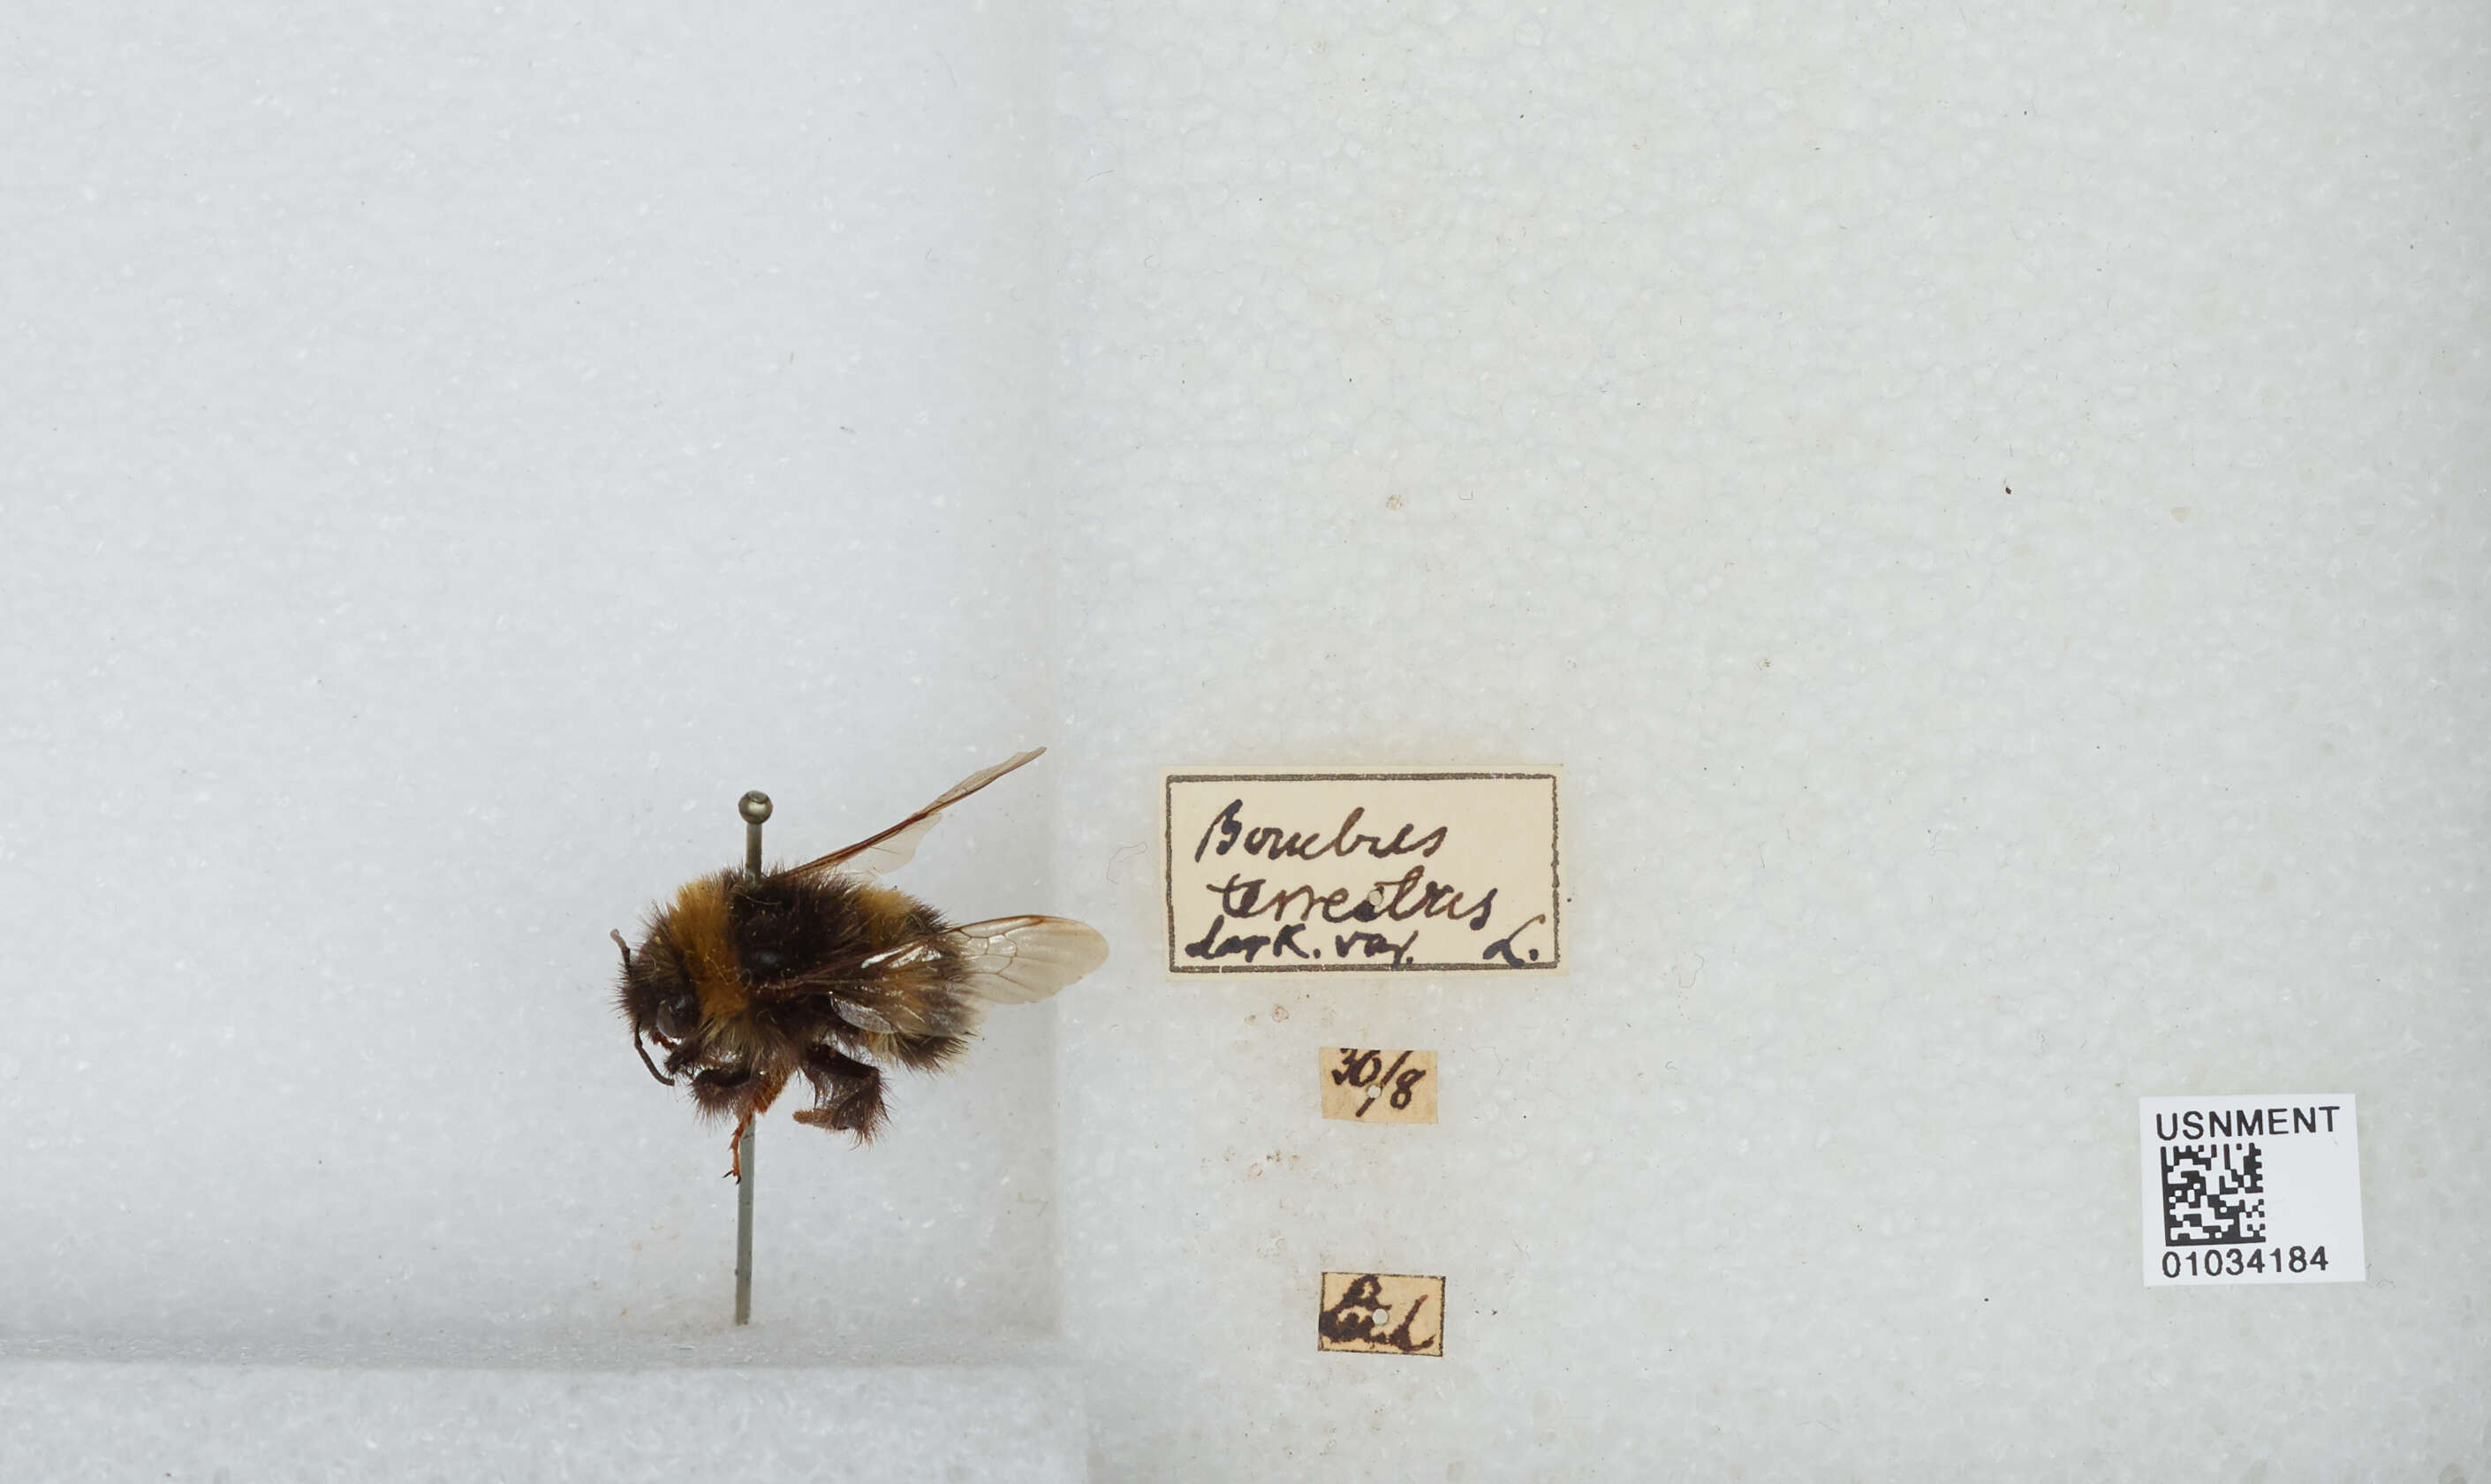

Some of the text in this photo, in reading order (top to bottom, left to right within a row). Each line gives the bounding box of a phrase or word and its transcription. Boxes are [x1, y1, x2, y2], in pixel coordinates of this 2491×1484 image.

[1194, 799, 1449, 863] Bombus
[2156, 1106, 2340, 1141] USNMENT
[2162, 1246, 2329, 1278] 01034184
